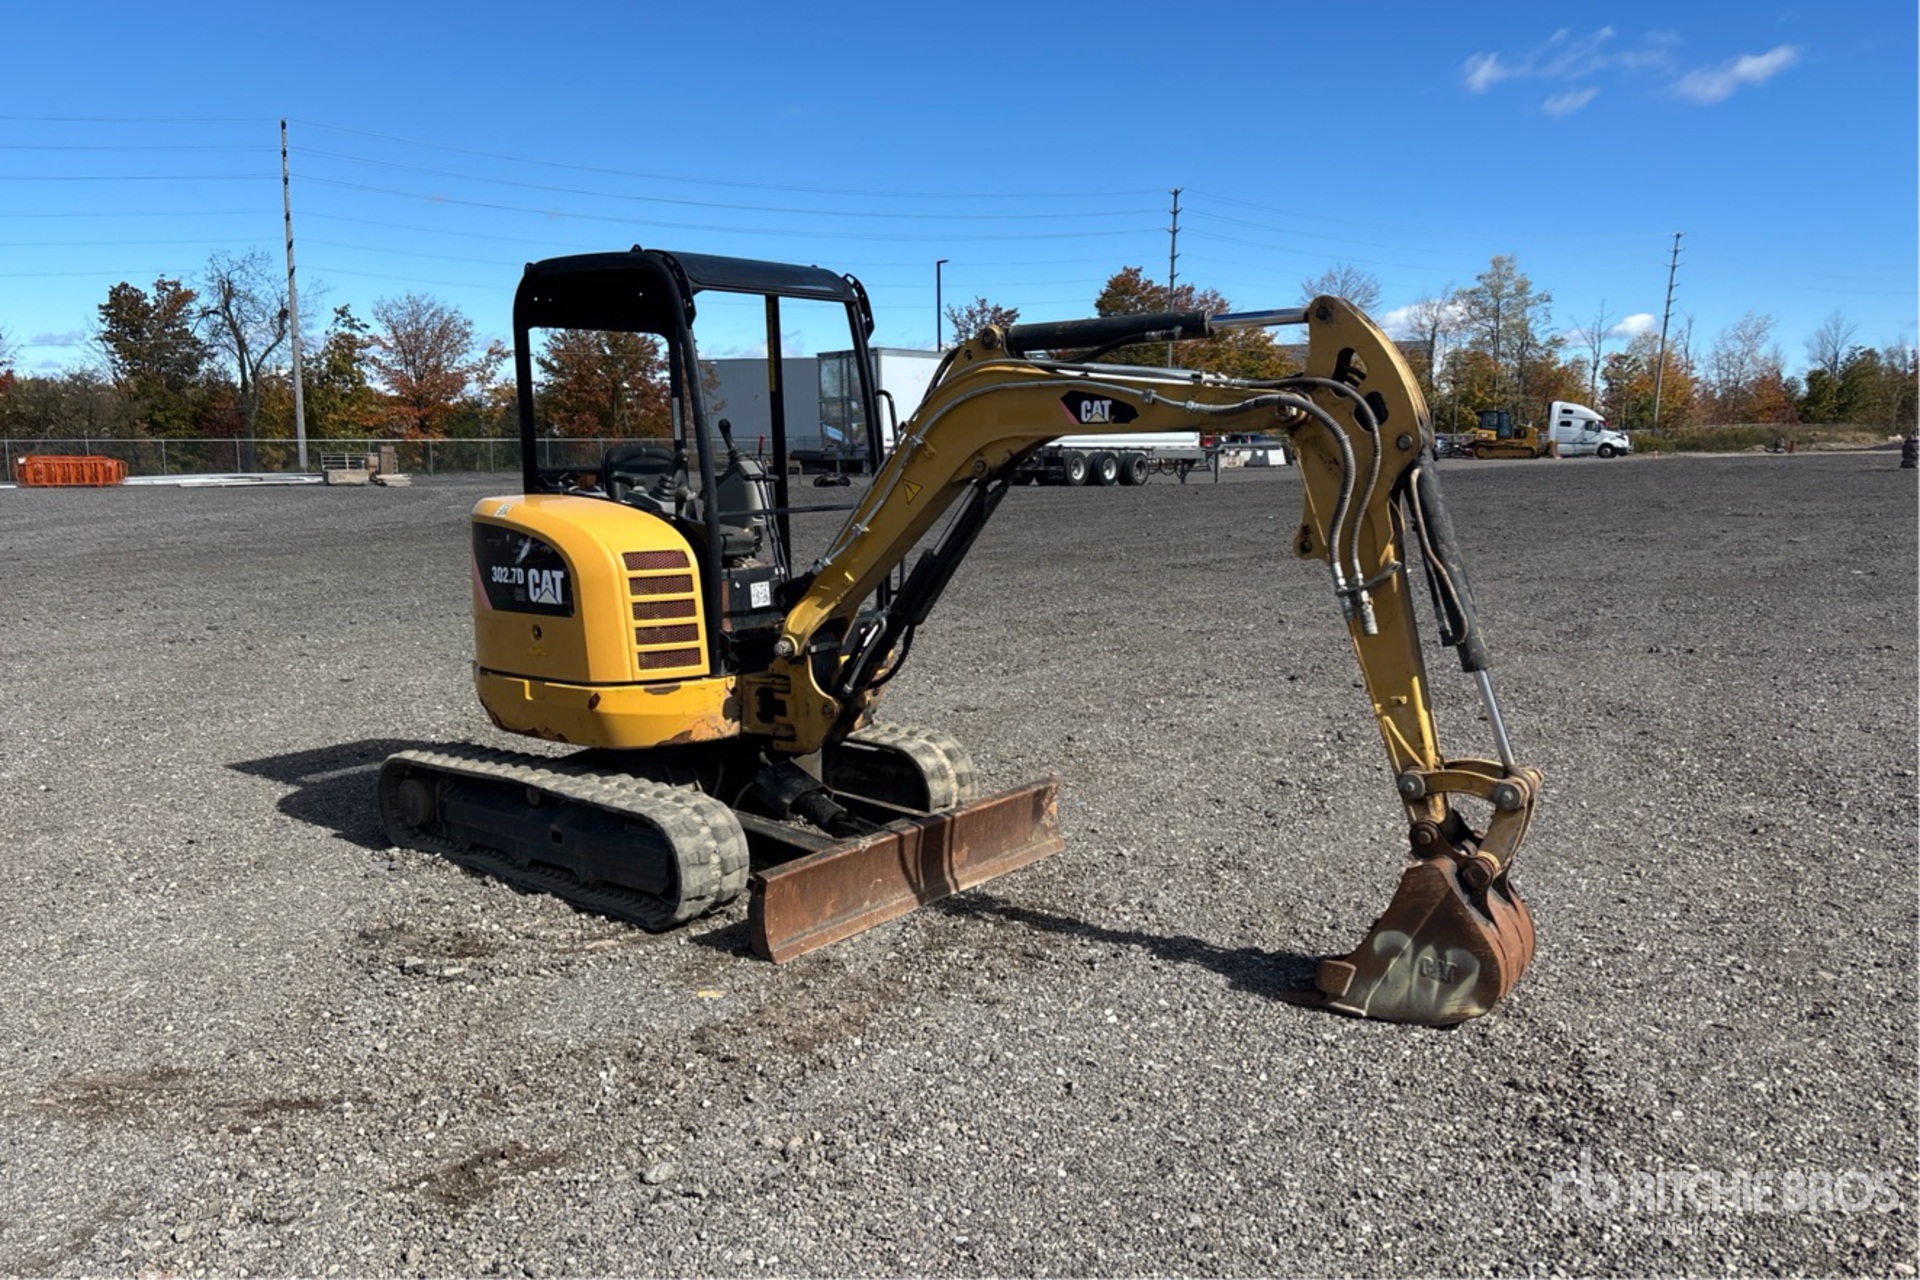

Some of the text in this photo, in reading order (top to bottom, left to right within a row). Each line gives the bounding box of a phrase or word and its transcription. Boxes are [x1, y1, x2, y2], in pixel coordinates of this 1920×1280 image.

[1080, 399, 1112, 423] CAT
[491, 566, 525, 585] 302.7D
[528, 568, 564, 605] CAT
[1419, 955, 1458, 984] CAT
